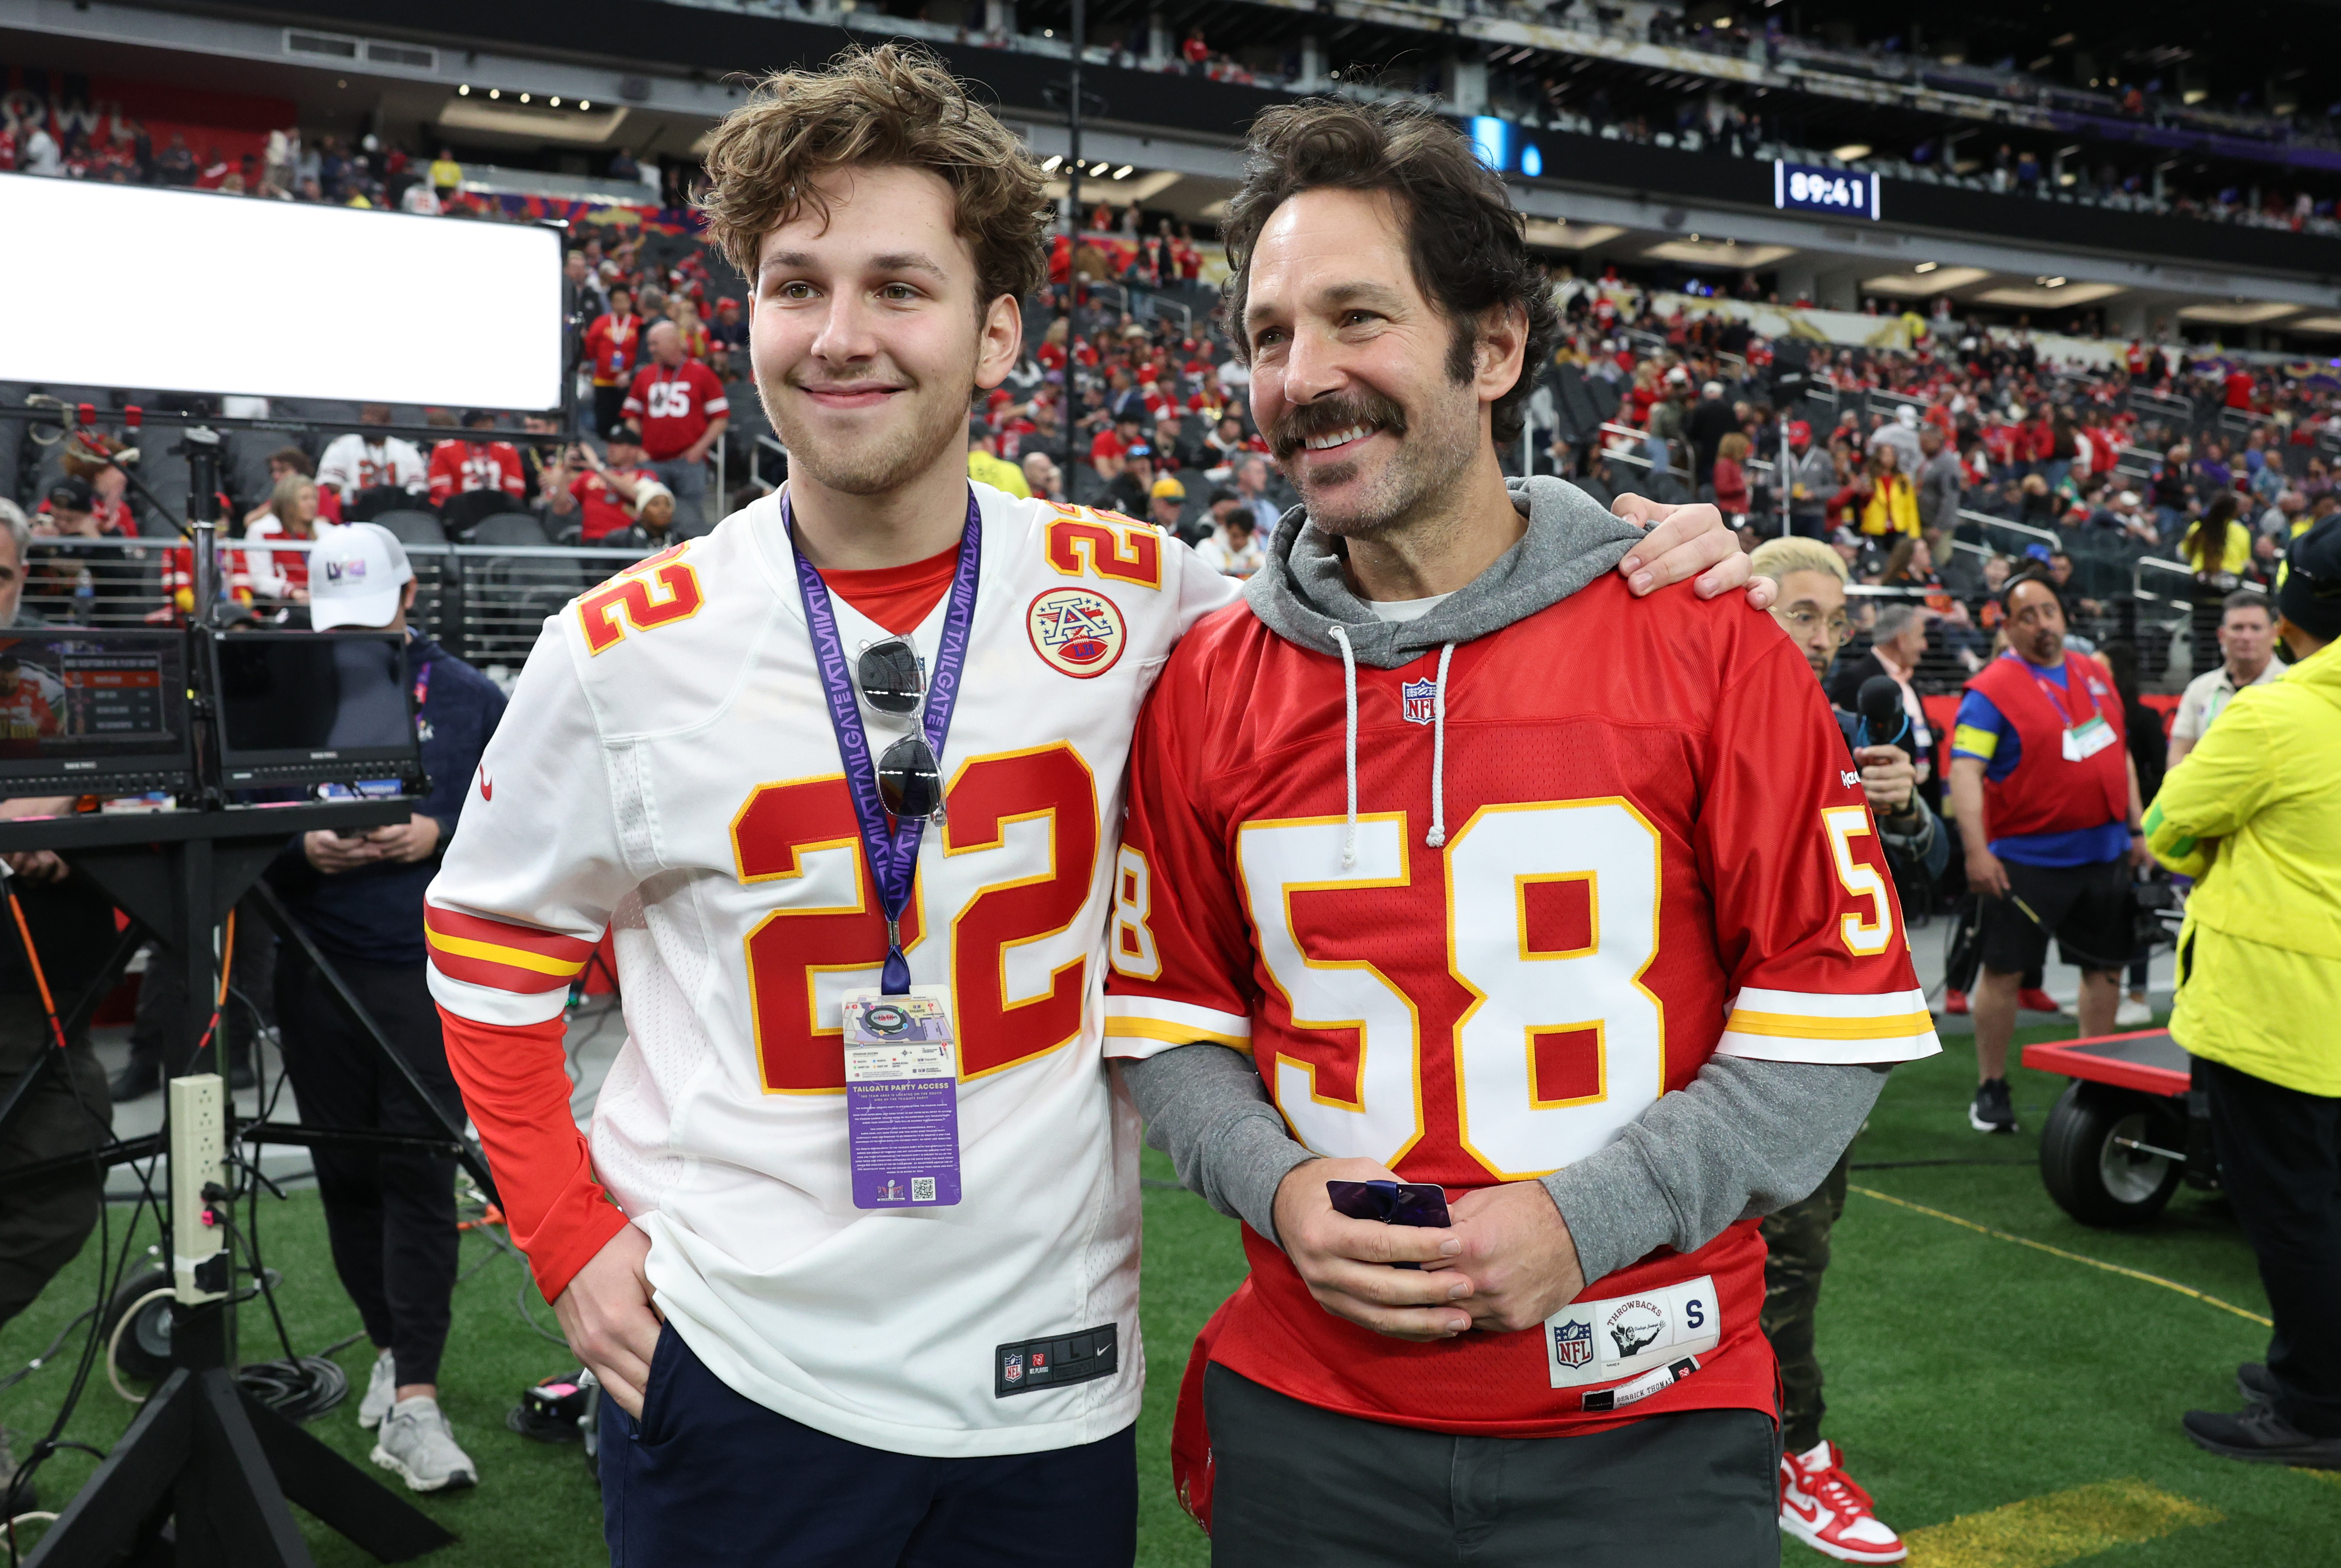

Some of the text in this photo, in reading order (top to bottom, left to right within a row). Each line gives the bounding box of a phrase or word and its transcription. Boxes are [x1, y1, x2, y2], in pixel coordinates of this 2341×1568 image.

[1790, 171, 1863, 208] 89:41
[1073, 643, 1096, 657] LH
[927, 630, 964, 727] TAILGATE
[833, 691, 873, 795] TAILGATE
[728, 738, 1101, 1095] 22
[1238, 796, 1665, 1181] 58
[1607, 1299, 1662, 1327] THROWBACKS
[1686, 1299, 1704, 1329] S
[1069, 1341, 1080, 1359] L
[1559, 1341, 1591, 1364] NFL
[1007, 1367, 1020, 1378] NFL
[1617, 1377, 1672, 1403] DERRICK THOMAS
